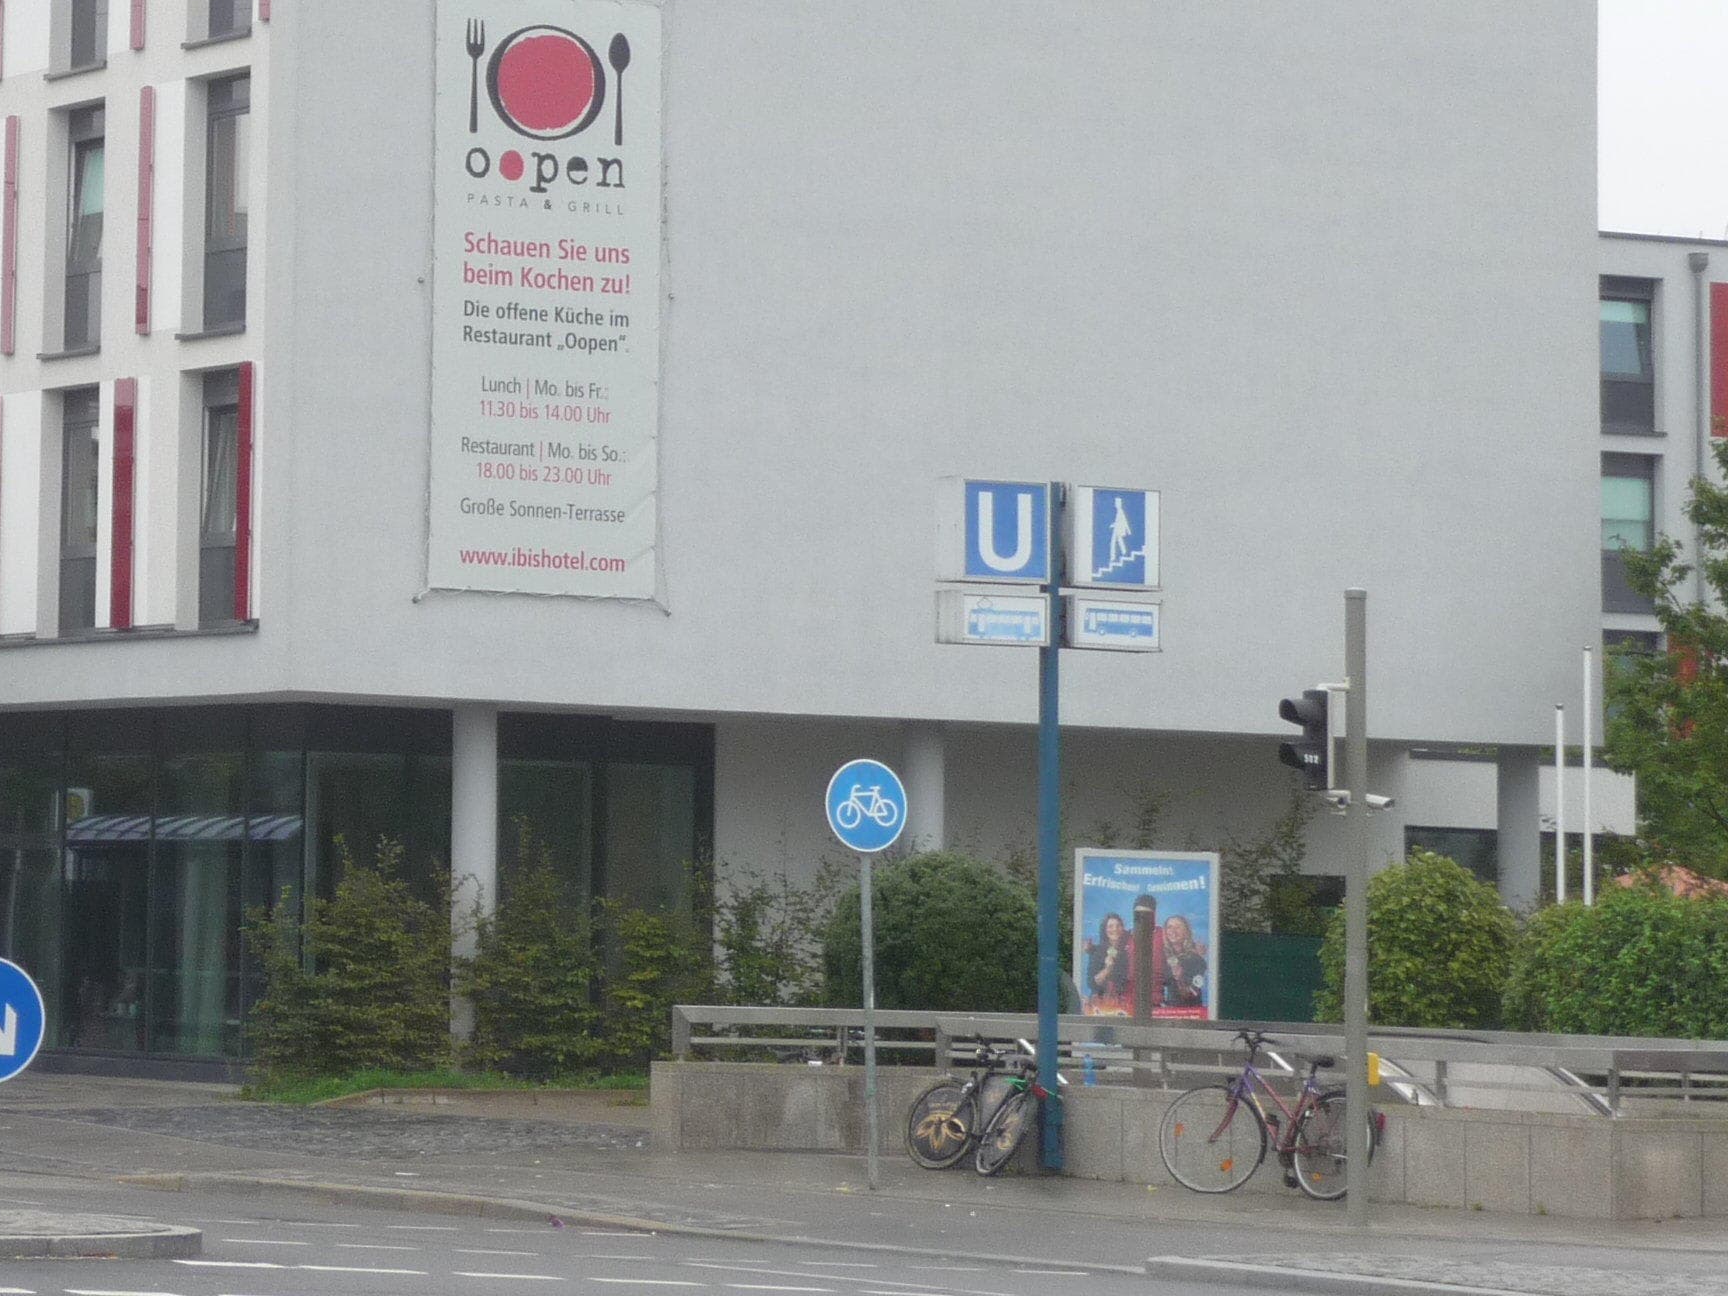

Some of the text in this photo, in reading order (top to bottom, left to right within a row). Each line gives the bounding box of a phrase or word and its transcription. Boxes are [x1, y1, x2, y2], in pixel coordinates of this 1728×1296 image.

[466, 193, 624, 216] PASTA & GRILL
[464, 232, 630, 264] Schauen Sie uns
[463, 261, 632, 295] beim Kochen zu!
[463, 300, 630, 328] Die offene Küche im
[462, 325, 552, 348] Restaurant
[481, 375, 522, 394] Lunch
[534, 378, 561, 397] Mo.
[565, 379, 585, 398] bis
[479, 400, 611, 424] 11.30 bis 14.00 Uhr
[460, 436, 535, 458] Restaurant
[547, 441, 573, 461] Mo.
[578, 442, 598, 462] bis
[476, 461, 612, 486] 18.00 bis 23.00 Uhr
[459, 497, 626, 524] Große Sonnen-Terrasse
[978, 491, 1033, 572] U
[459, 546, 626, 572] www.ibishotel.com
